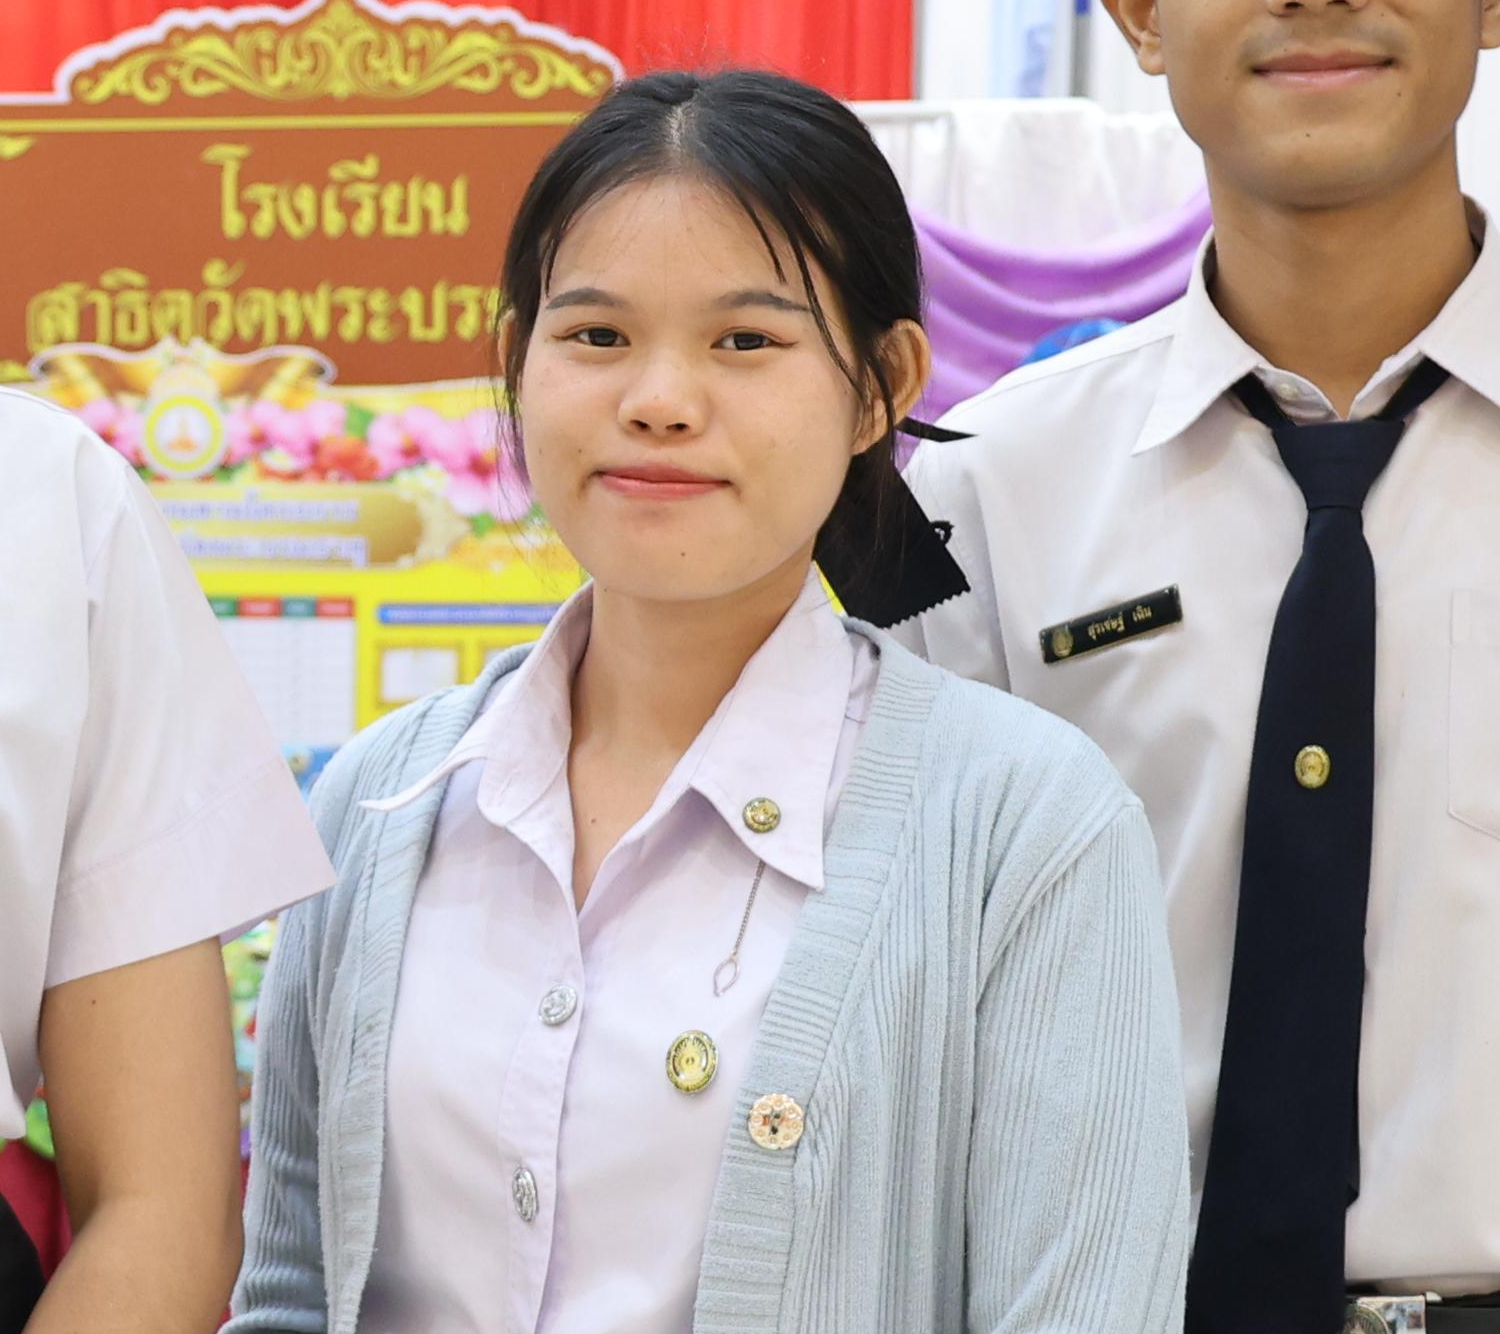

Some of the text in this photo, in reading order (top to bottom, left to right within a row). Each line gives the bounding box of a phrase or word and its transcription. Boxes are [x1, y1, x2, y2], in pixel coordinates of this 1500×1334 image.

[200, 142, 472, 240] โรงเรียน
[24, 258, 503, 355] สาธิตวัดพระบร
